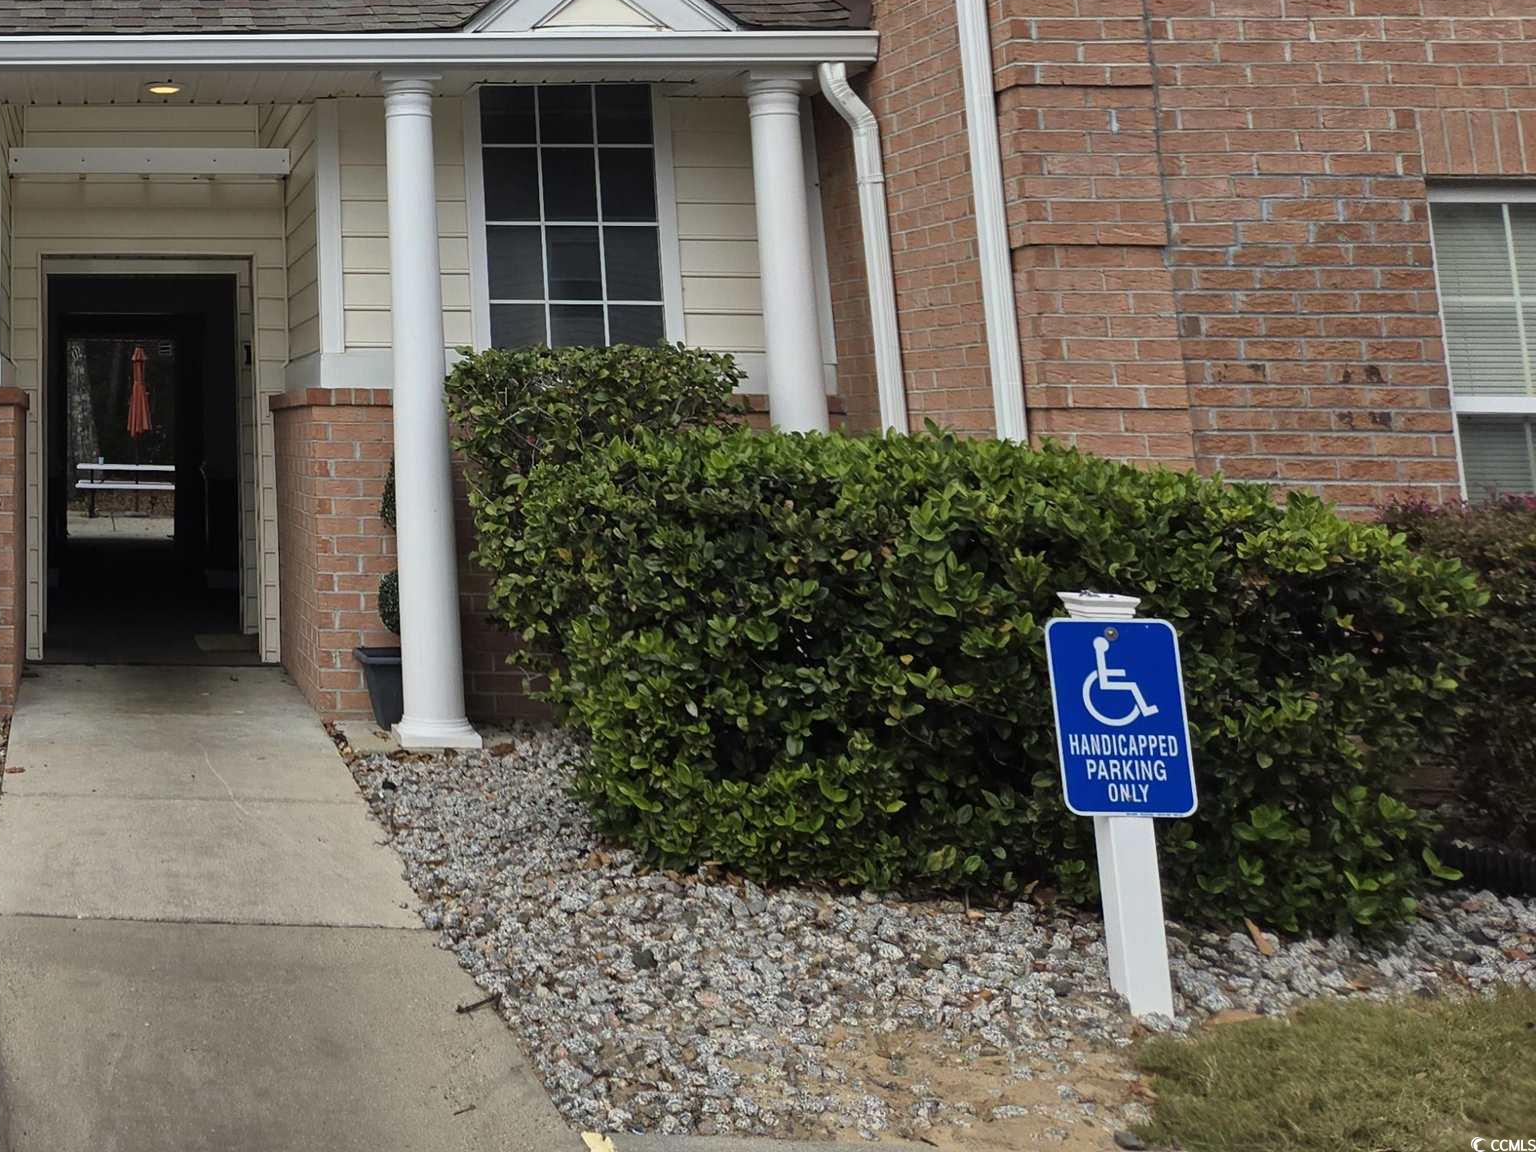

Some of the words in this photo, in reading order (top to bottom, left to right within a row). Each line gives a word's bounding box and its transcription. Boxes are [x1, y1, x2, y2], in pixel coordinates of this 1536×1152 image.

[1068, 734, 1178, 757] HANDICAPPED
[1086, 759, 1167, 781] PARKING
[1108, 783, 1149, 803] ONLY
